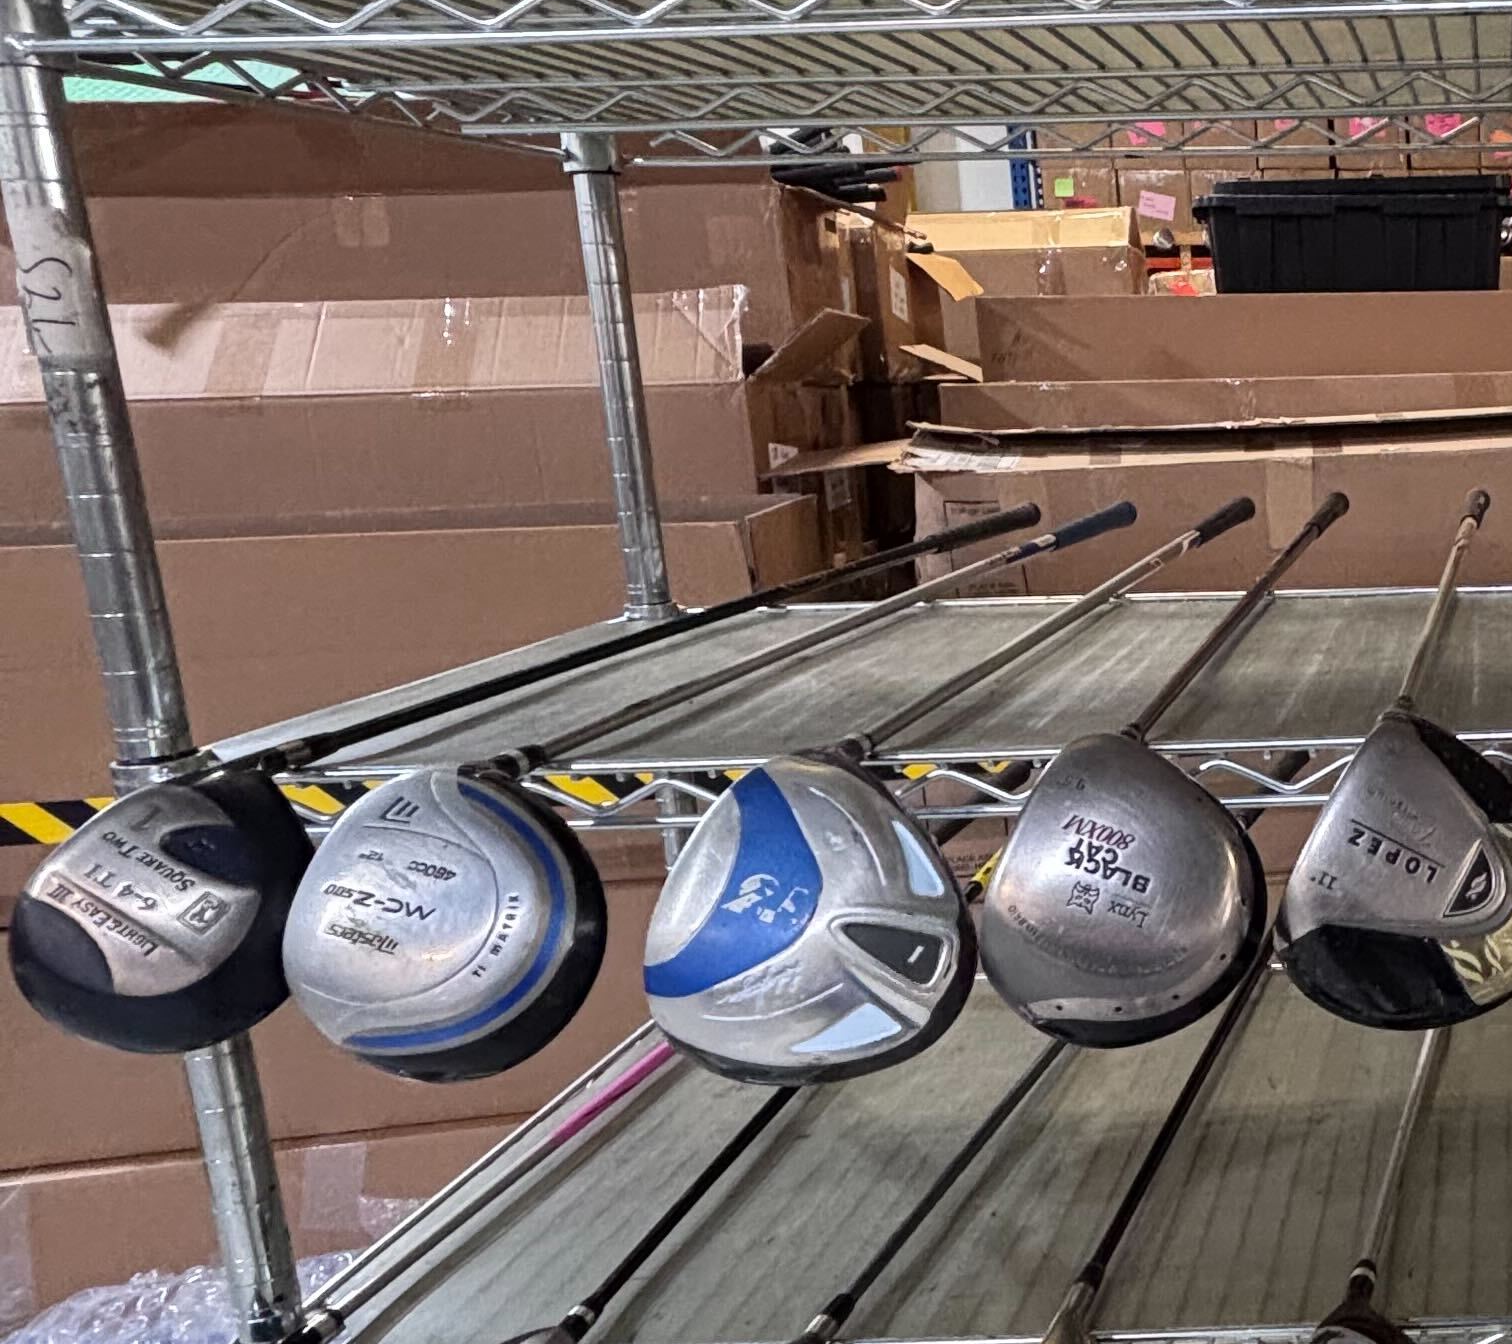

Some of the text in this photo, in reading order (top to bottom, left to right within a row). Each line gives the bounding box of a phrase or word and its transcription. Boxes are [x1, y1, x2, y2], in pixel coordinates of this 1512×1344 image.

[1062, 815, 1137, 851] 800XM
[1069, 837, 1119, 865] CAT
[102, 830, 195, 893] SQUARE TWO
[1063, 850, 1151, 895] BLACK
[1350, 826, 1438, 884] LOPEZ
[1106, 897, 1149, 929] Lynx
